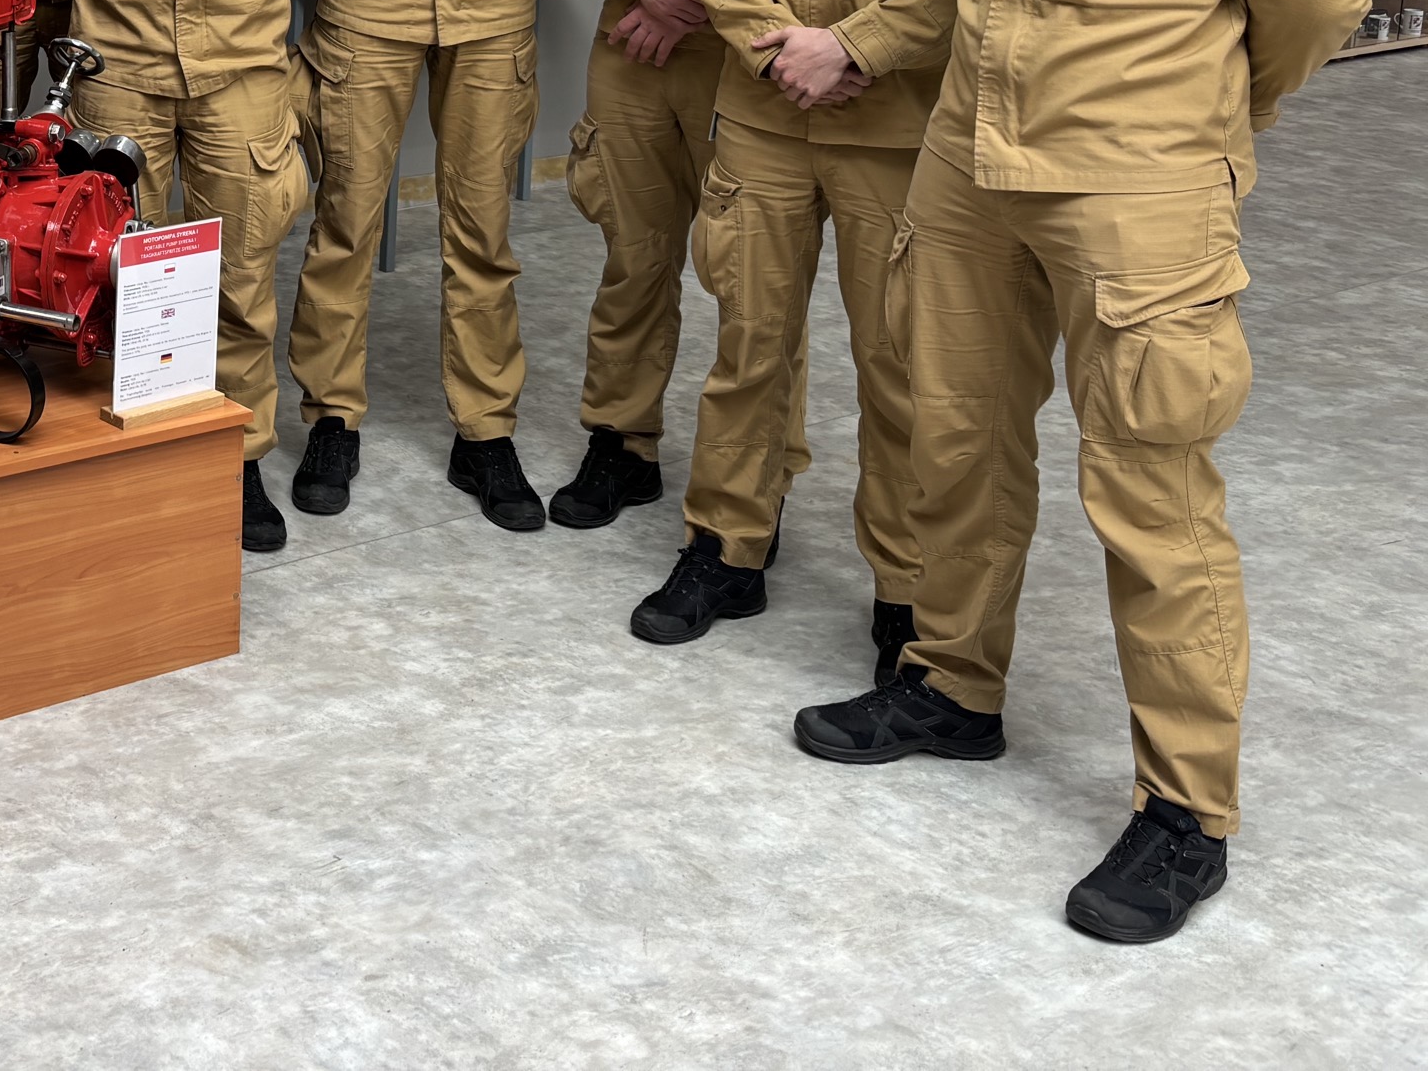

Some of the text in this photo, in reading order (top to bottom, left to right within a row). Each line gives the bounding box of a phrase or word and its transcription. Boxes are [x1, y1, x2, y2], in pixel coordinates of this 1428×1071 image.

[143, 230, 196, 244] MOTOPOMPA SYRENA
[144, 243, 165, 251] PORTABLE
